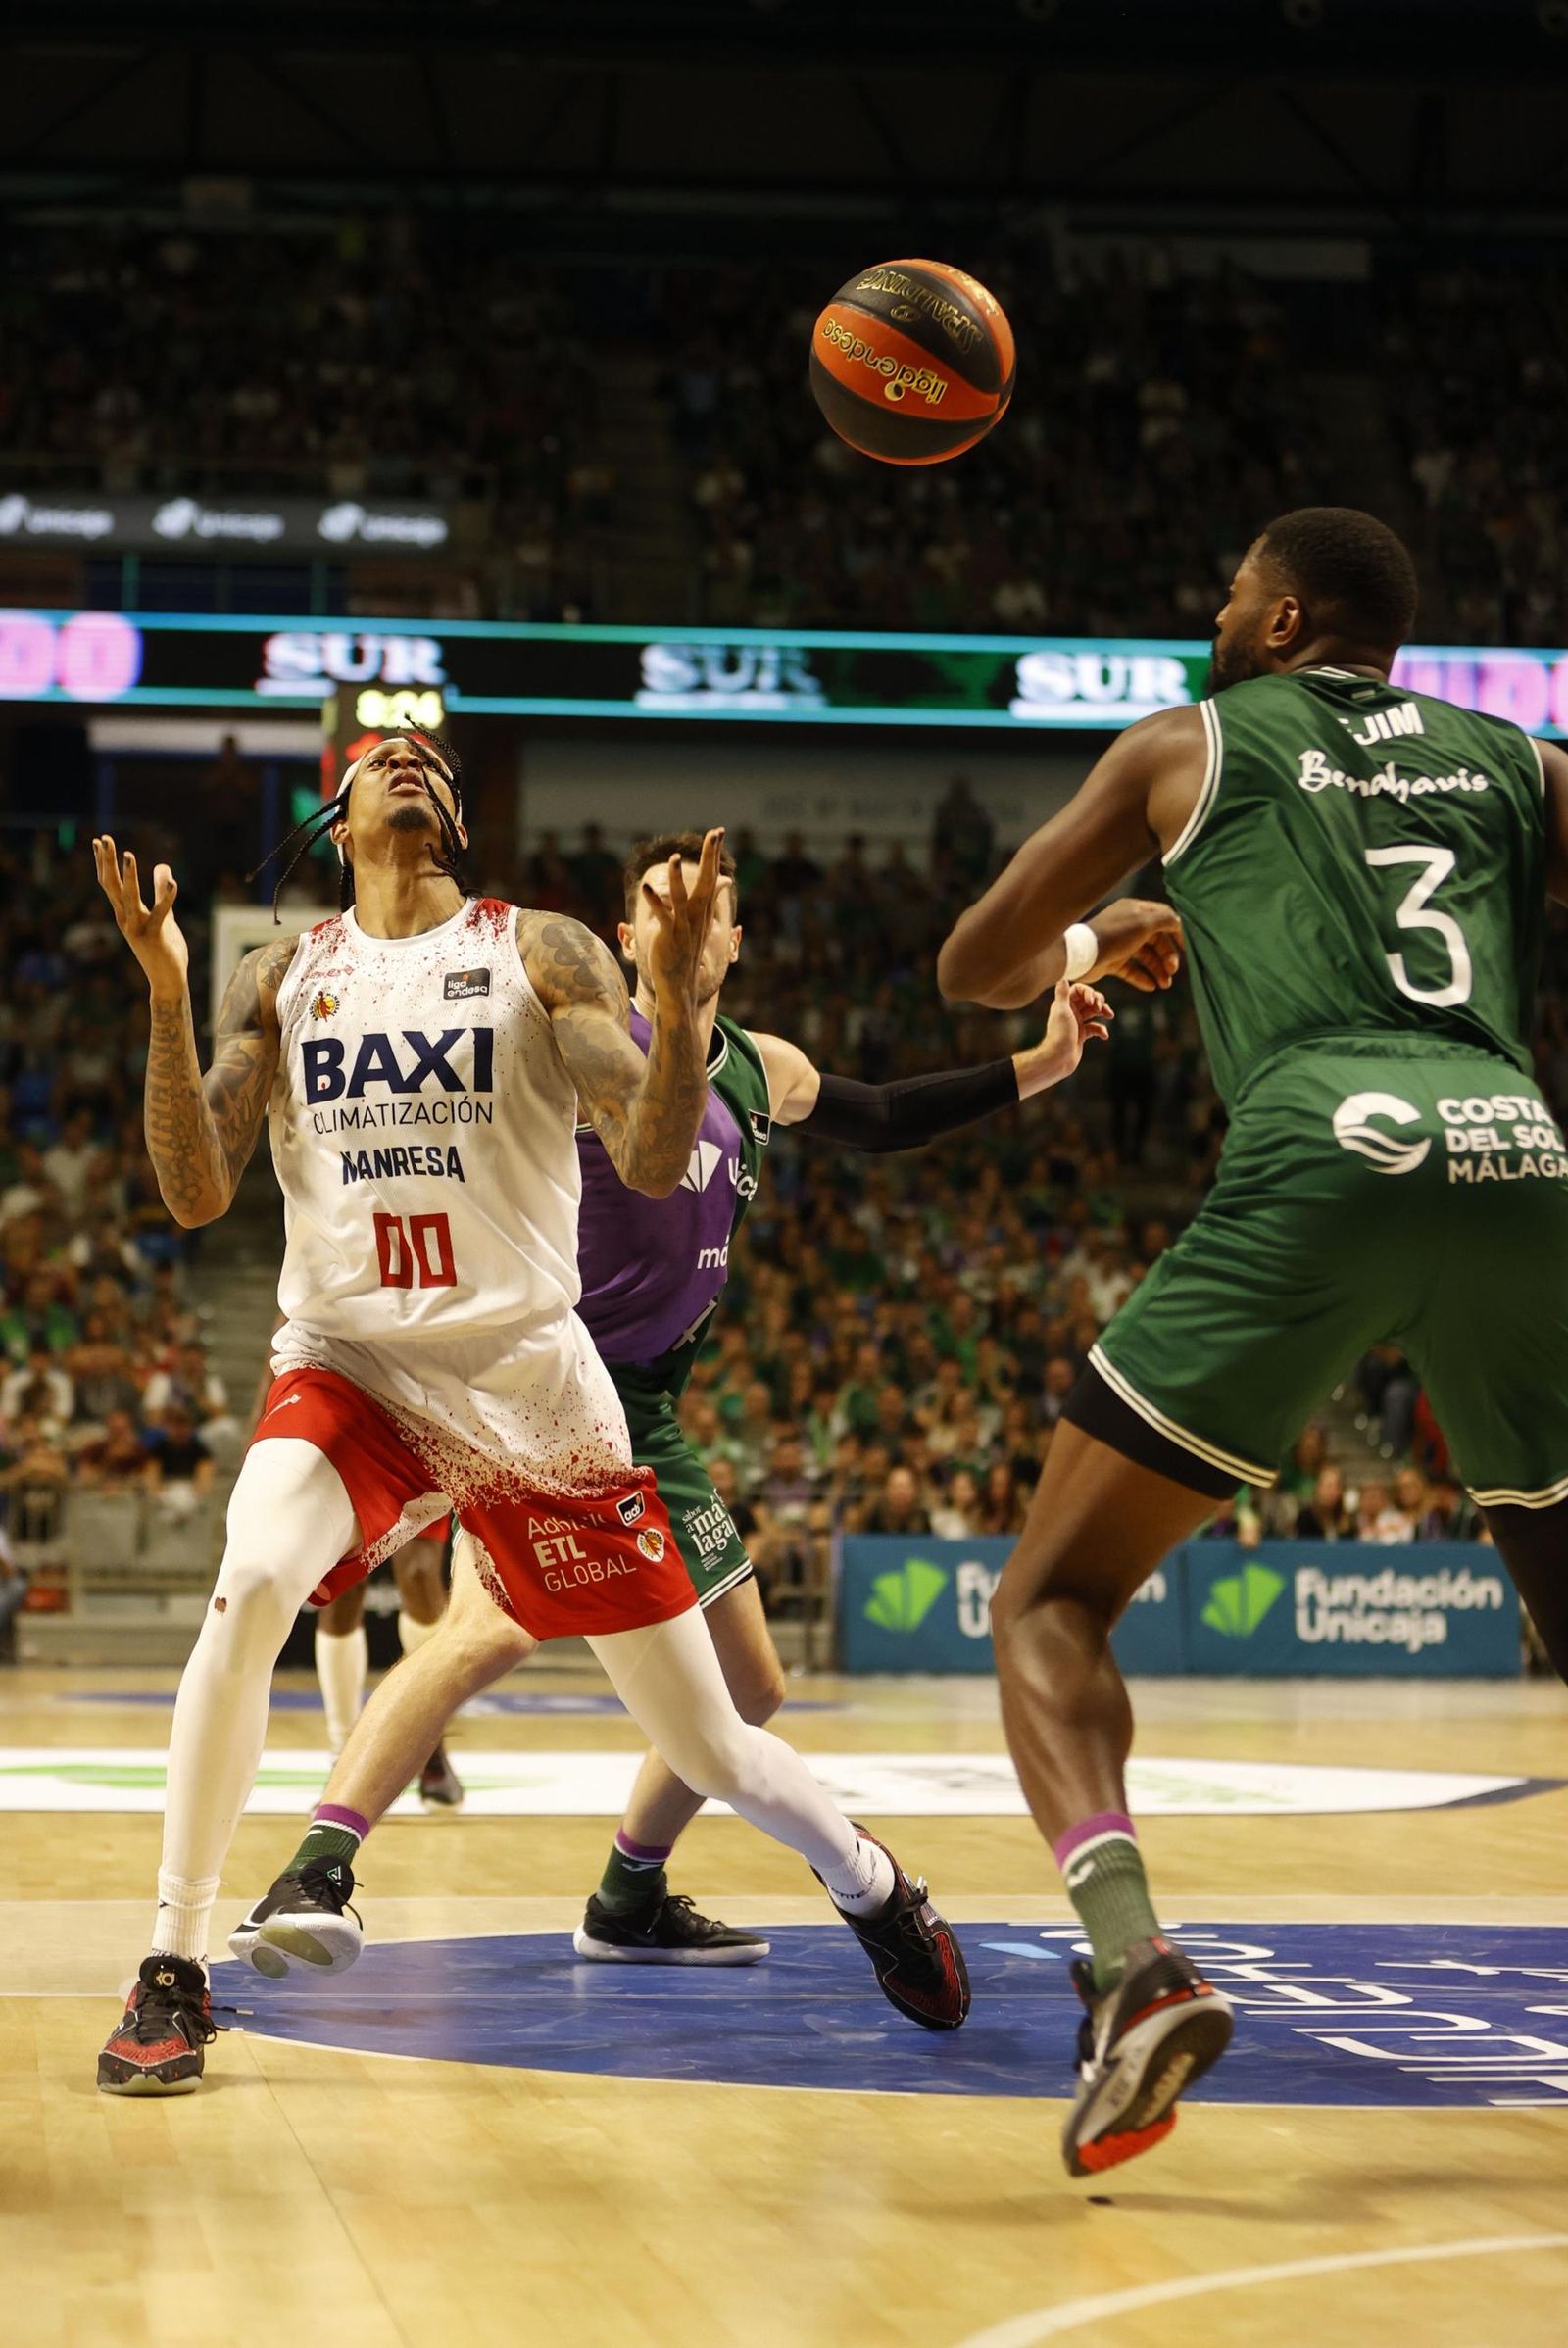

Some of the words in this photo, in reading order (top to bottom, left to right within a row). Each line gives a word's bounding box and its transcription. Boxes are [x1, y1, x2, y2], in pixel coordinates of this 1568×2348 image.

[1015, 651, 1190, 705] SUR
[1365, 845, 1472, 1008] 3
[301, 1027, 494, 1105] BAXI
[313, 1097, 493, 1135] CLIMATIZACIÓN
[1436, 1095, 1554, 1125] COSTA
[1445, 1128, 1512, 1154] DEL
[1515, 1124, 1566, 1154] SOL
[372, 1212, 458, 1289] 00
[533, 1535, 587, 1568] ETL
[544, 1555, 637, 1592] GLOBAL
[1295, 1568, 1503, 1609] Fundación
[1295, 1609, 1447, 1653] Unicaja
